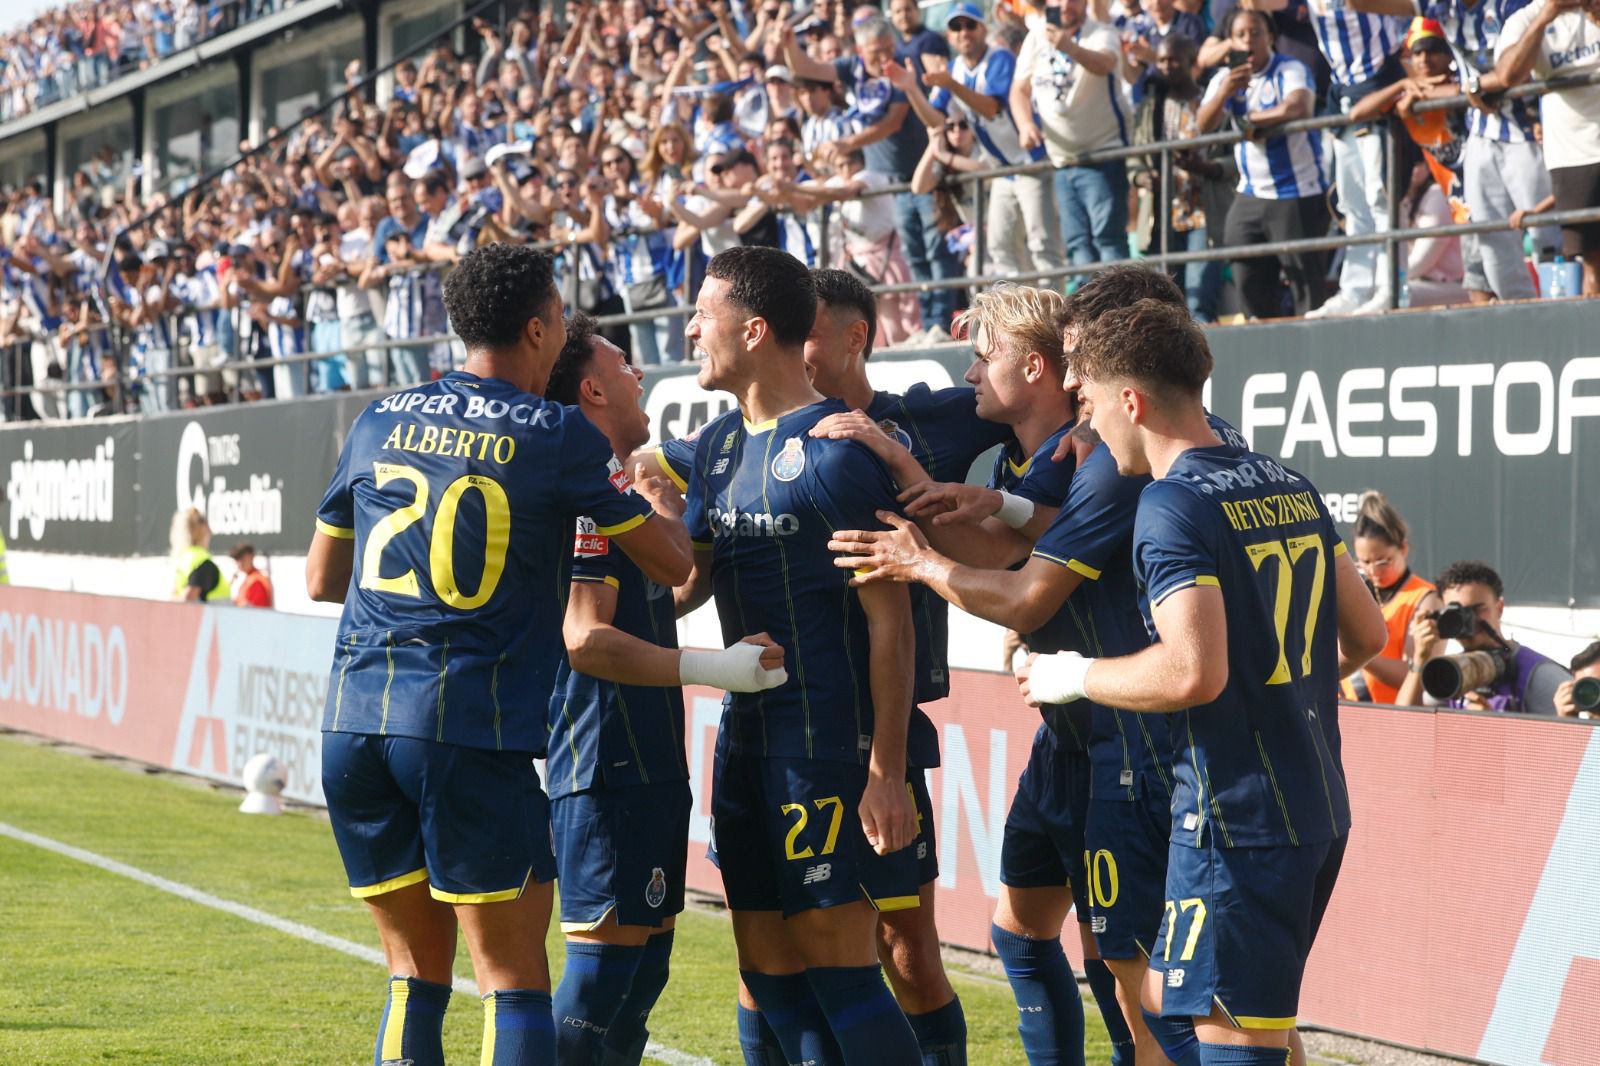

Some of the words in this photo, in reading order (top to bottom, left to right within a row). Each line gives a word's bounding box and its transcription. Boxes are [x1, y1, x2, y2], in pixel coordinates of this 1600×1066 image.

[375, 393, 458, 415] SUPER
[464, 395, 552, 430] BOCK
[382, 423, 516, 465] ALBERTO
[7, 436, 115, 541] pigmenti
[359, 461, 512, 610] 20
[576, 537, 605, 552] tclic
[1245, 533, 1326, 686] 77
[781, 795, 844, 861] 27
[1084, 849, 1119, 908] 10
